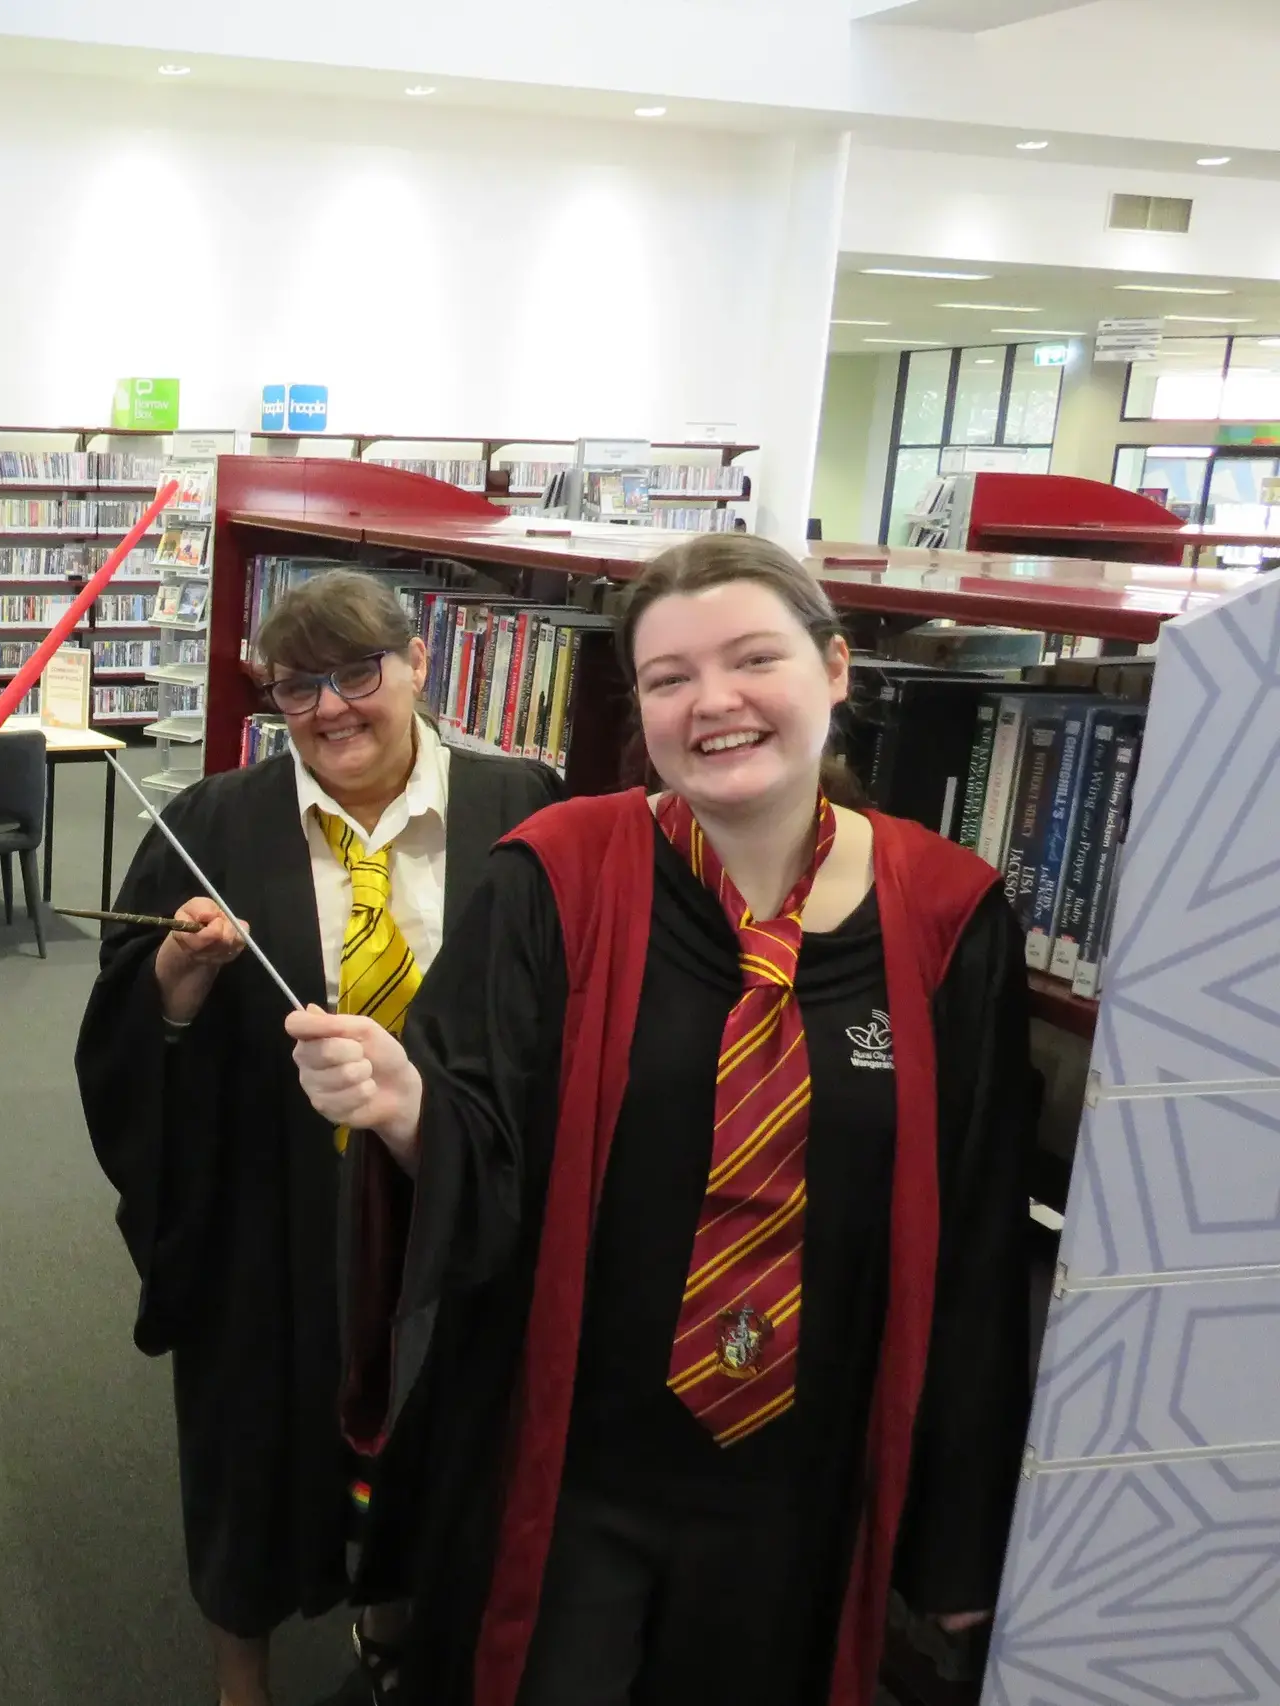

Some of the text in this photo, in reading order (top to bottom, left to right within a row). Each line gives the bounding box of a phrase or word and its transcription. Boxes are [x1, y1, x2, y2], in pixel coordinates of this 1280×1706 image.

[134, 399, 169, 410] Borrow
[289, 398, 326, 417] hoopla
[503, 631, 523, 747] SHELLEY HARRIS VIGILANTE
[958, 744, 981, 845] ELIZABETH JACK
[967, 726, 994, 838] KICKING OVER THE
[1019, 751, 1047, 838] WITHOUT MERCY
[1049, 735, 1079, 820] CHURCHILL'S
[1083, 769, 1103, 810] Wing
[1108, 770, 1125, 805] Shirley
[1081, 810, 1093, 829] and
[1100, 806, 1118, 848] Jackson
[1018, 865, 1036, 895] LISA
[1069, 839, 1091, 884] Prayer
[1030, 864, 1051, 919] JACKSON
[1040, 879, 1055, 911] RUBY
[1059, 887, 1075, 928] Jackson
[1070, 896, 1085, 925] Ruby
[853, 1050, 873, 1059] Rural
[873, 1051, 887, 1061] City
